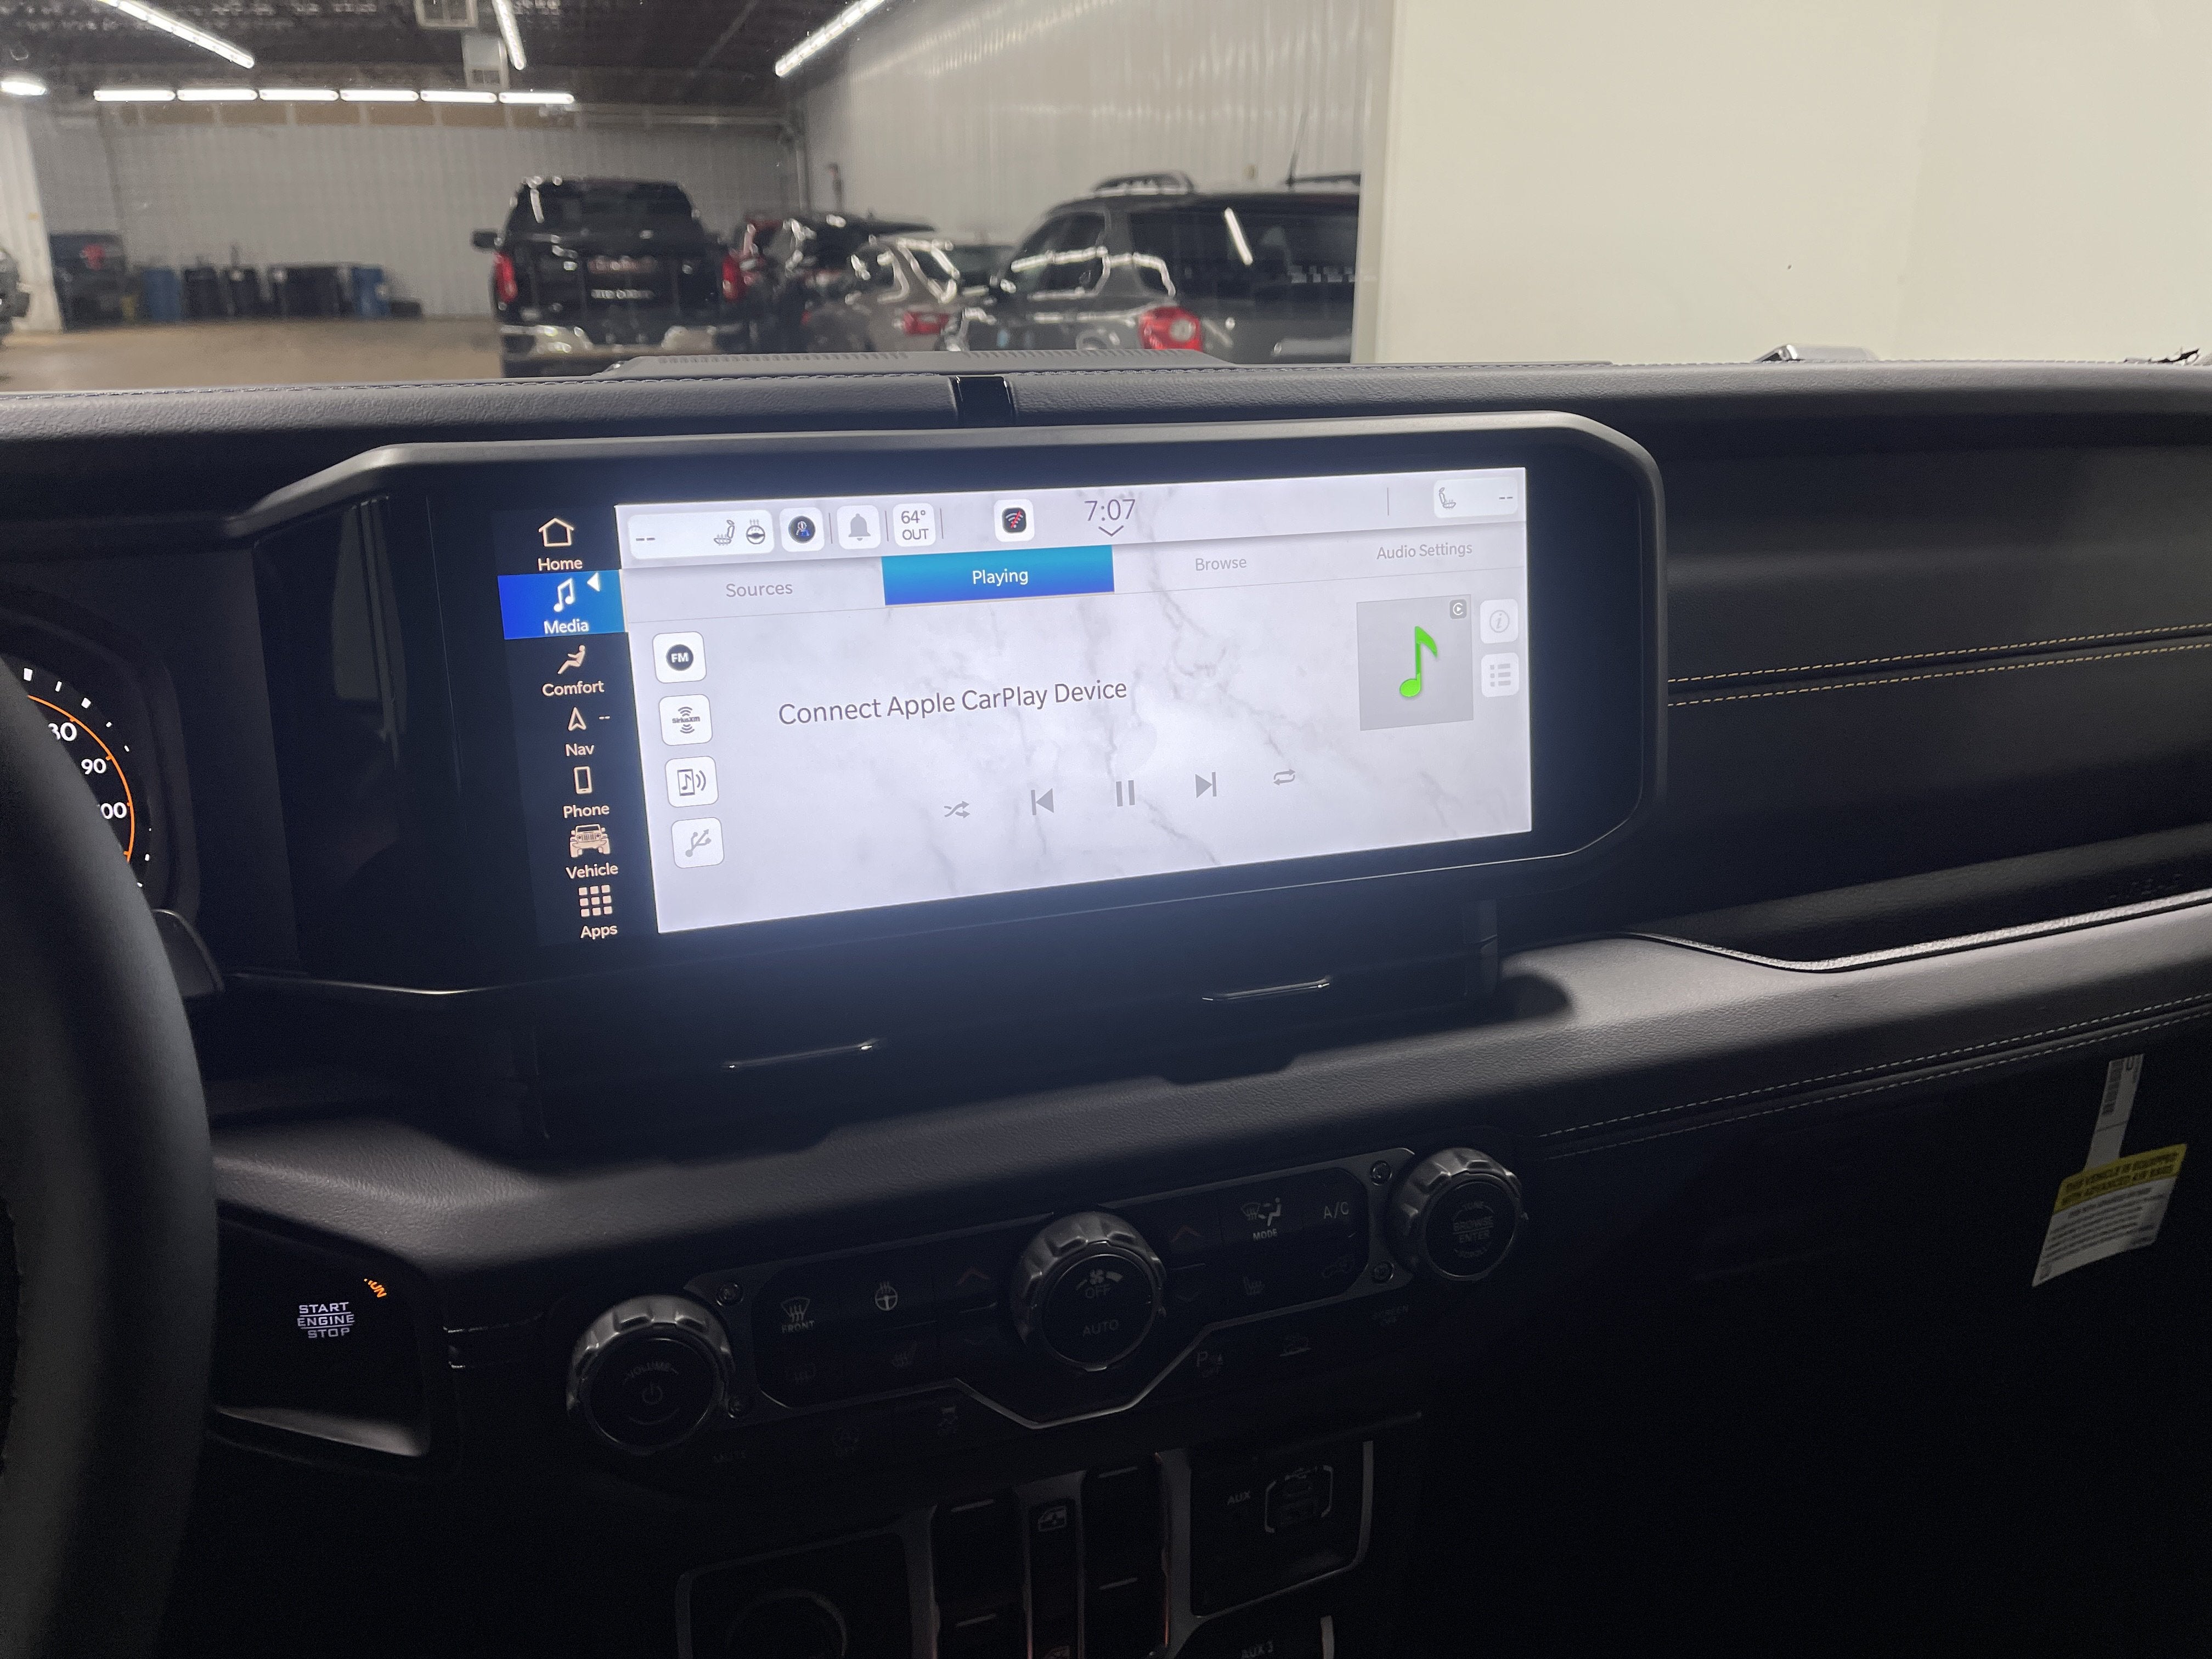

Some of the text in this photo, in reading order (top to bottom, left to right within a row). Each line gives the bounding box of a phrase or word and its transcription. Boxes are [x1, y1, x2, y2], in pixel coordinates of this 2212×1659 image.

[1085, 499, 1136, 522] 7:07
[902, 528, 929, 540] OUT
[1376, 542, 1473, 560] Audio Settings
[538, 556, 583, 571] Home
[1195, 556, 1247, 572] Browse
[972, 568, 1029, 586] Playing
[725, 582, 794, 599] Sources
[544, 619, 589, 634] Media
[671, 652, 690, 663] FM
[541, 680, 605, 697] Comfort
[778, 679, 1128, 725] Connect Apple CarPlay Device
[565, 742, 595, 757] Nav
[81, 758, 106, 774] 90
[100, 802, 127, 819] 00
[563, 805, 610, 819] Phone
[566, 862, 619, 879] Vehicle
[580, 925, 618, 939] Apps
[1324, 1201, 1349, 1220] A/C
[1453, 1215, 1494, 1232] BROWSE
[1253, 1228, 1278, 1242] MODE
[1459, 1229, 1490, 1244] ENTER
[1086, 1284, 1110, 1300] OFF
[299, 1302, 349, 1314] START
[297, 1314, 355, 1327] ENGINE
[781, 1320, 815, 1334] FRONT
[1082, 1318, 1119, 1338] AUTO
[308, 1327, 351, 1339] STOP
[1227, 1489, 1252, 1505] AUX
[1241, 1644, 1265, 1659] AUX
